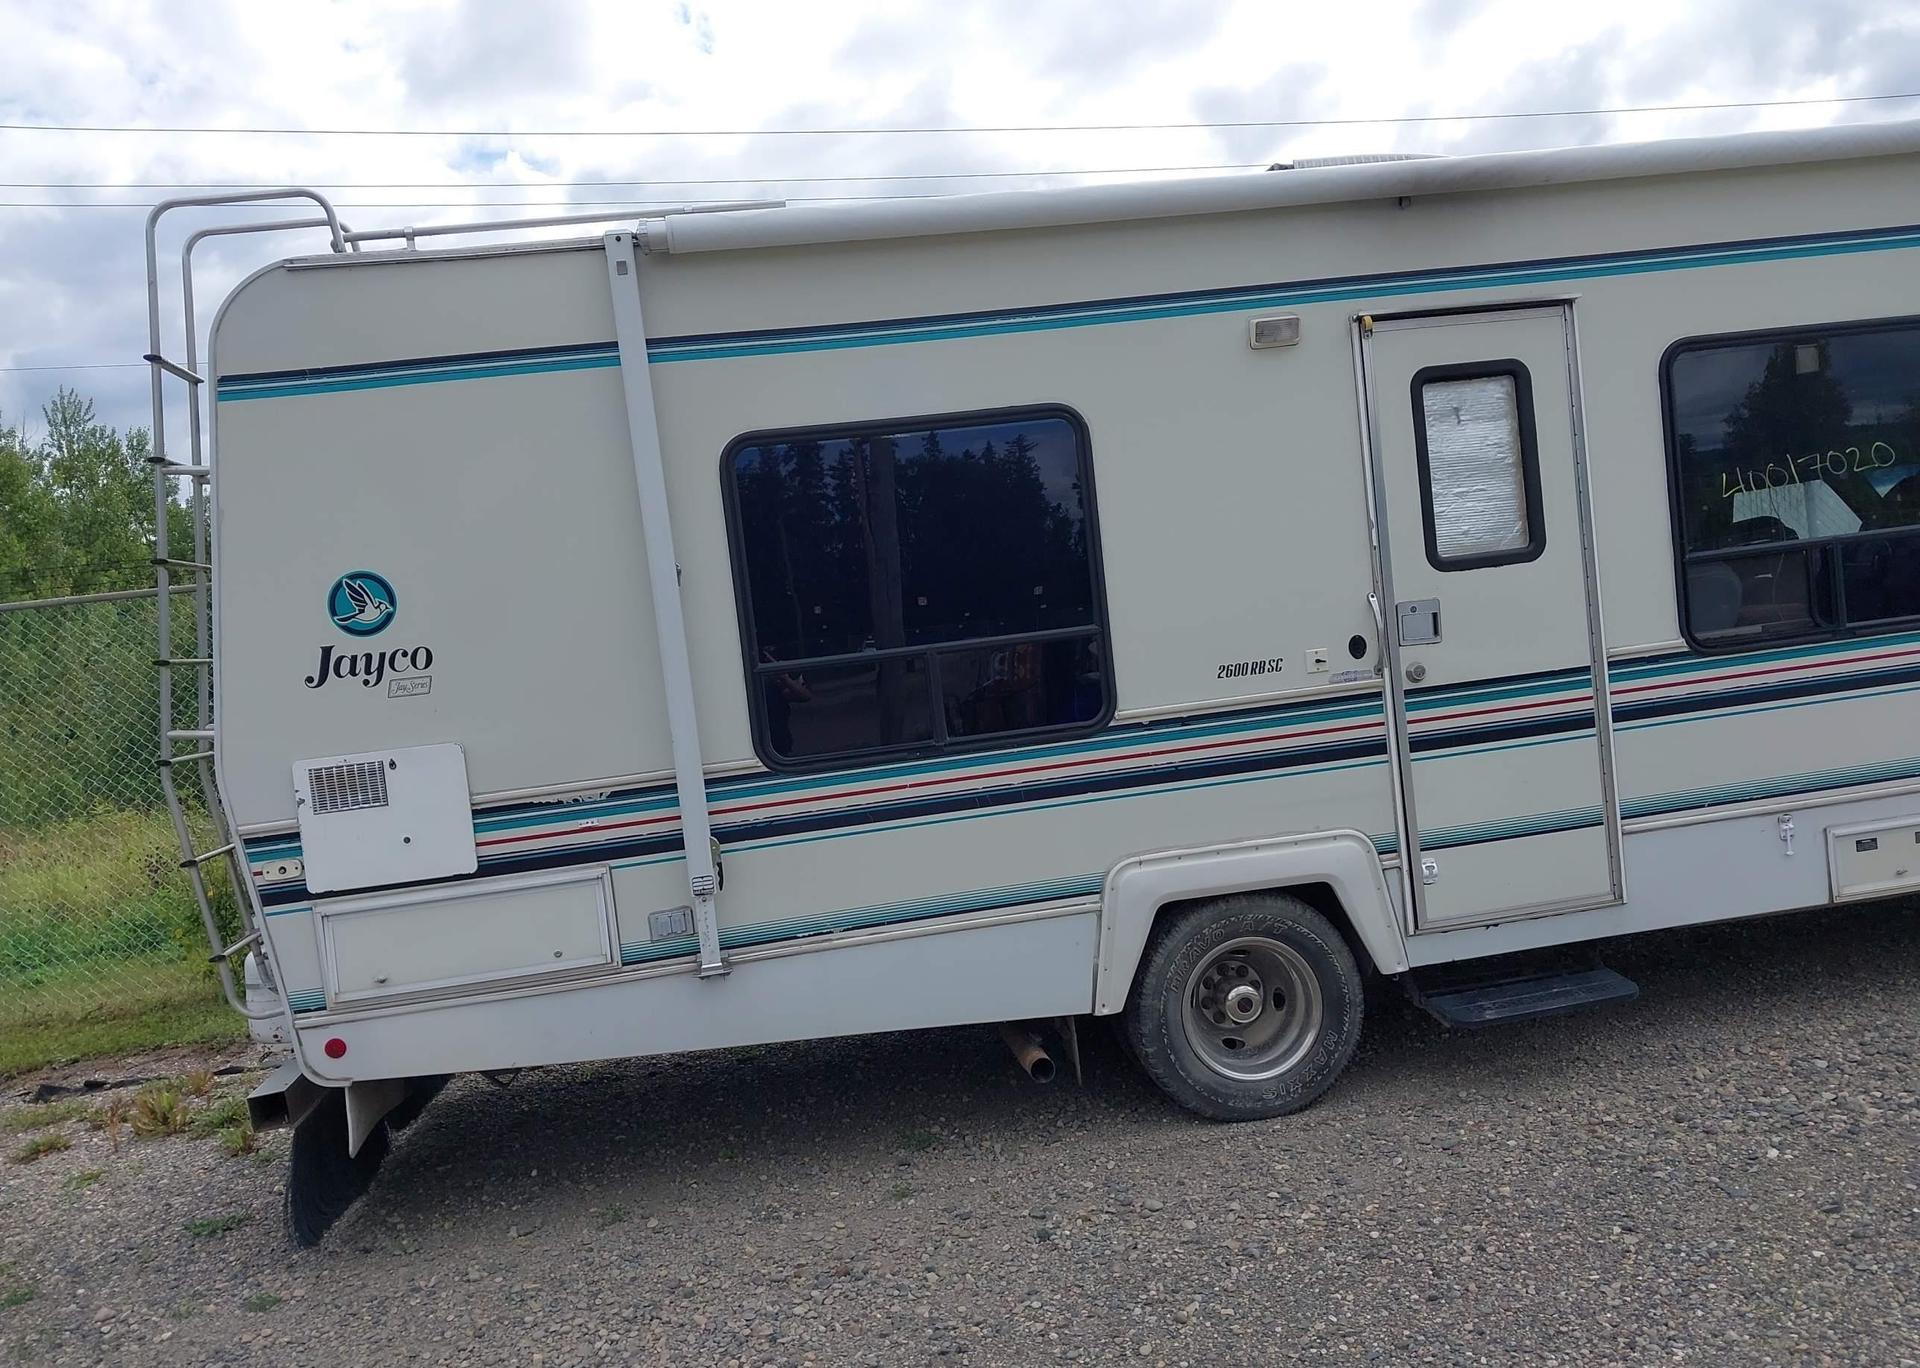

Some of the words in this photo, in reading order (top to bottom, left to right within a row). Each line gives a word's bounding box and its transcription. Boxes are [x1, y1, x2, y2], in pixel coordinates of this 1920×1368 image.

[1722, 441, 1896, 498] 40017020
[304, 644, 434, 689] Jayco
[1262, 1030, 1338, 1100] MAXXIS
